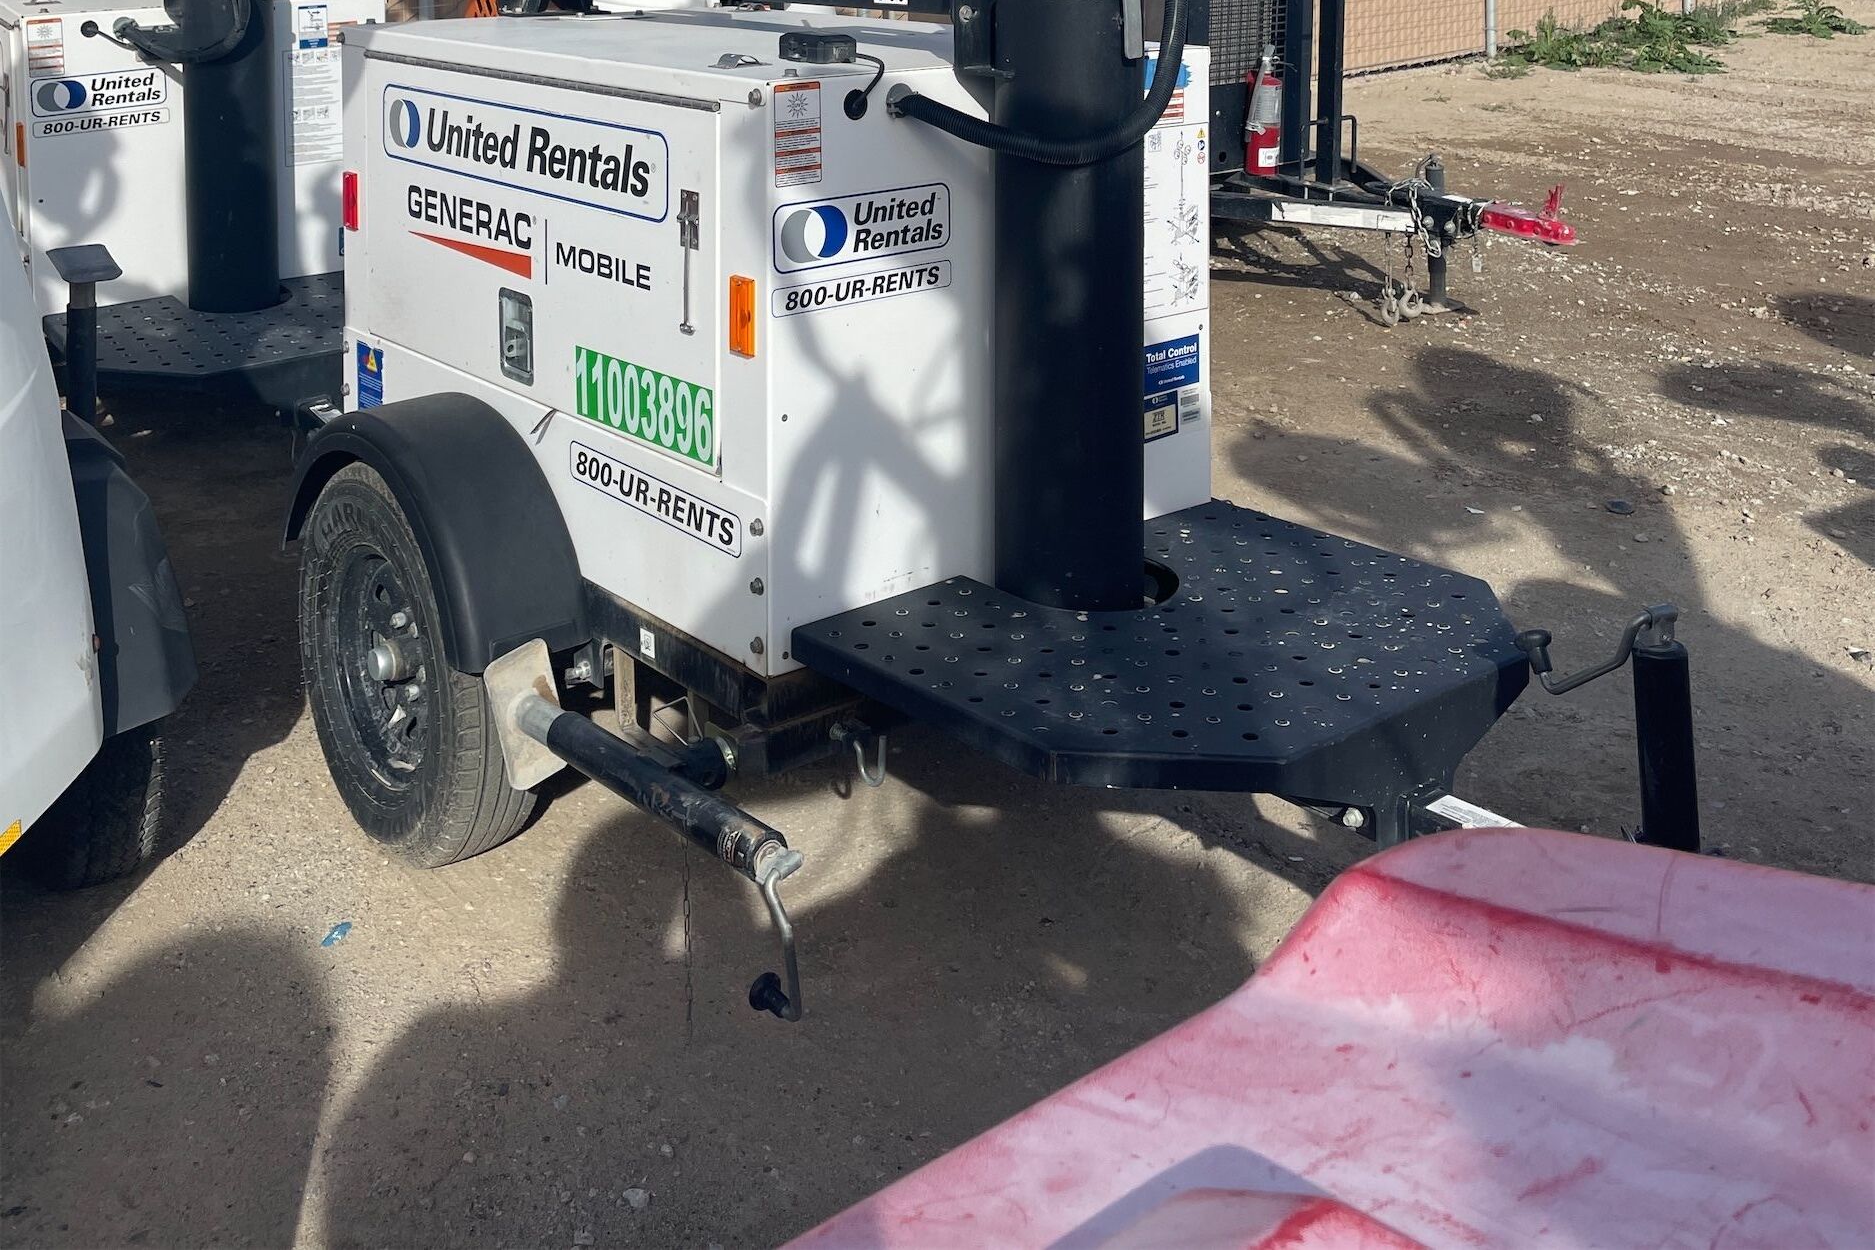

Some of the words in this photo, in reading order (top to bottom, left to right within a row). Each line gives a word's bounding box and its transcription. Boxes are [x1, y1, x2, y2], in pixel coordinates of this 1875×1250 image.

[91, 72, 155, 92] United
[91, 87, 161, 107] Rentals
[43, 110, 161, 135] 800-UR-RENTS
[426, 107, 520, 169] United
[526, 125, 651, 198] Rentals
[407, 184, 532, 250] GENERAC
[853, 191, 937, 226] United
[853, 218, 944, 253] Rentals
[556, 241, 651, 291] MOBILE
[785, 265, 940, 311] 800-UR-RENTS
[1146, 349, 1166, 363] Total
[1168, 342, 1197, 358] Control
[1146, 361, 1175, 374] Telematics
[1175, 356, 1197, 368] Enabled
[576, 348, 712, 463] 11003896
[576, 451, 735, 546] 800-UR-RENTS
